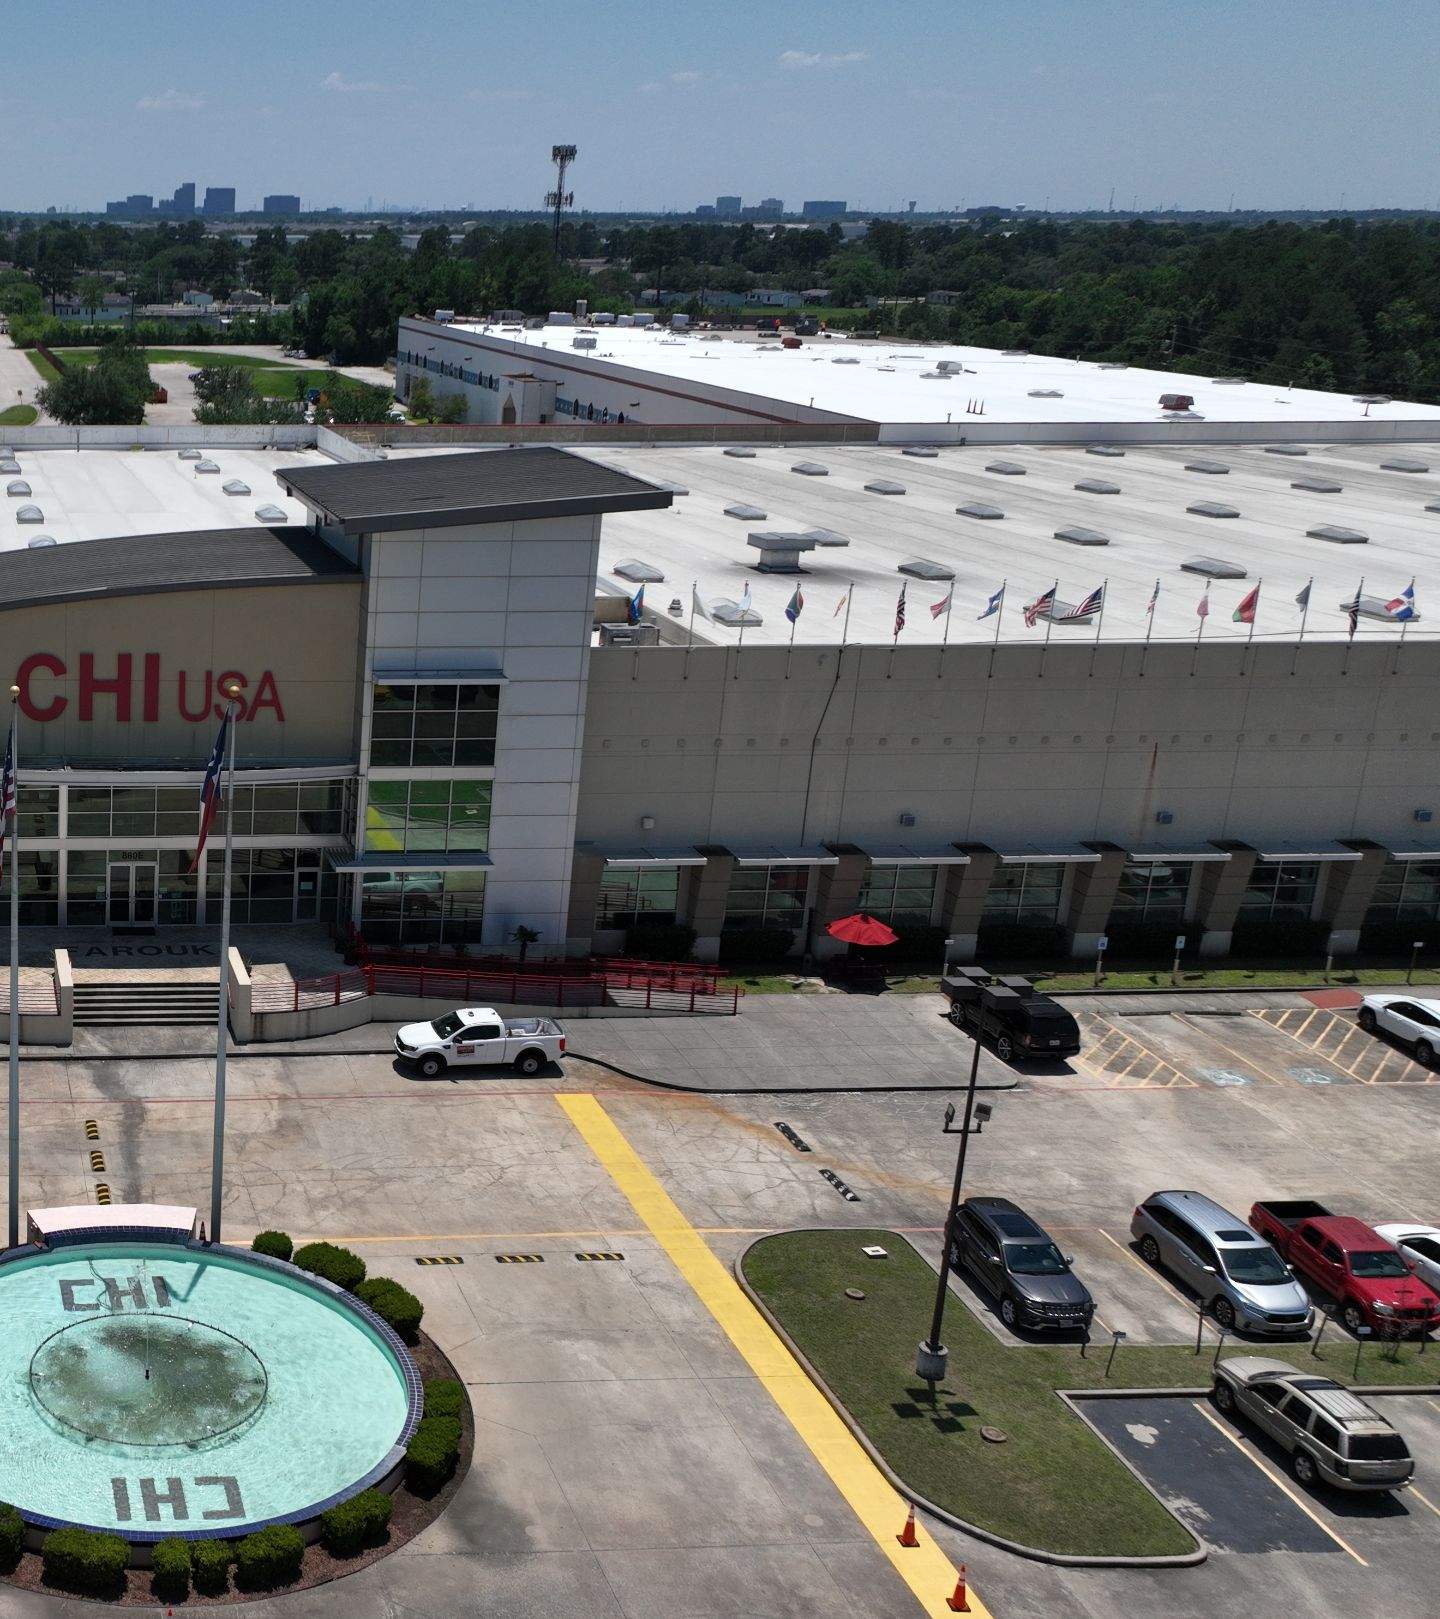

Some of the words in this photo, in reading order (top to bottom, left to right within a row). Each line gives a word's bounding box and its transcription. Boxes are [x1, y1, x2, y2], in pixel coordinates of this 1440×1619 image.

[15, 653, 160, 722] CHI
[178, 670, 285, 722] USA
[59, 1275, 171, 1312] CHI
